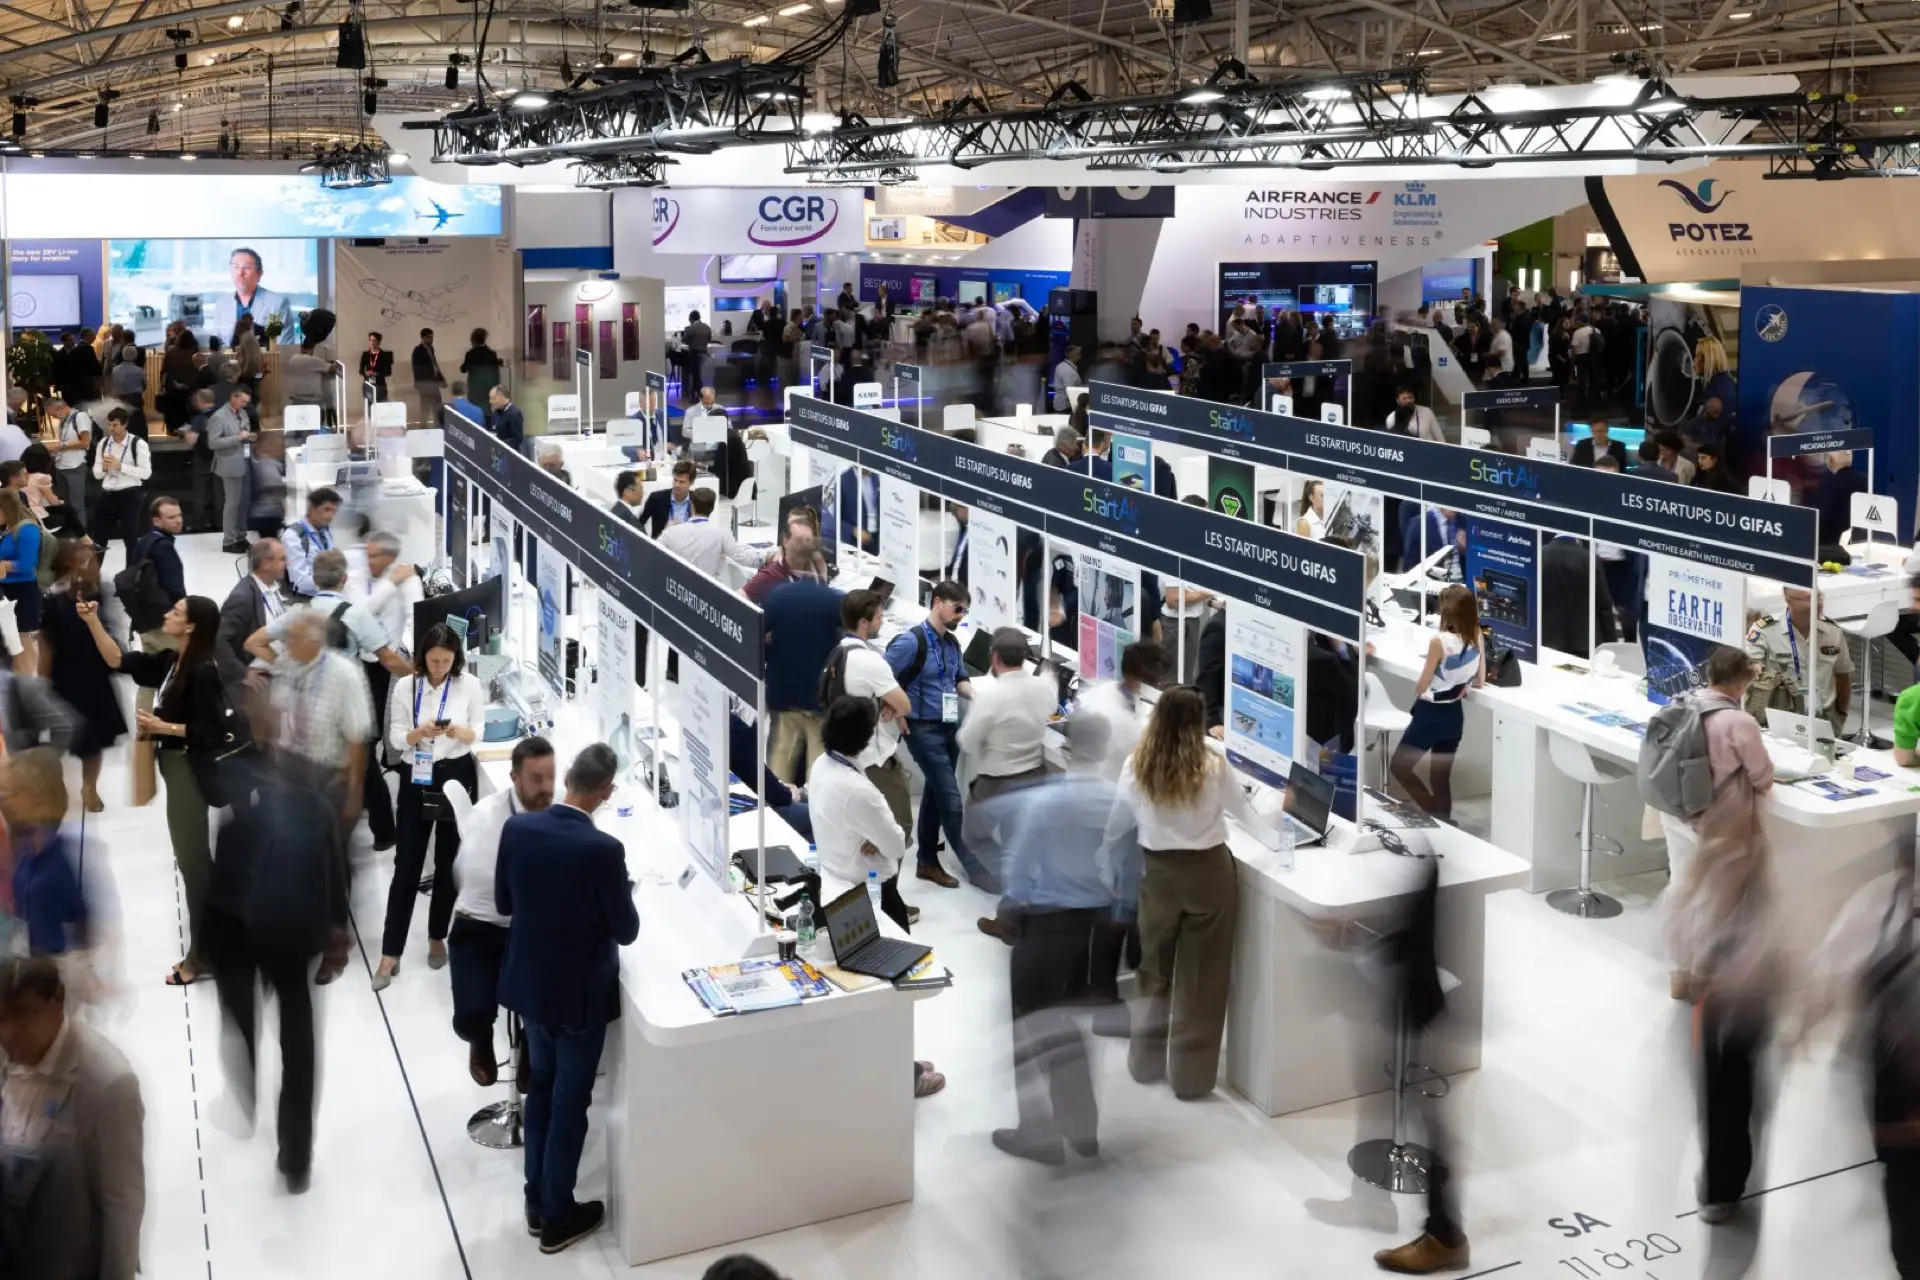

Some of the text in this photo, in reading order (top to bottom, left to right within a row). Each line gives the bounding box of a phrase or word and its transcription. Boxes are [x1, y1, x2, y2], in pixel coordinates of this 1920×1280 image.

[758, 195, 825, 222] CGR
[1246, 190, 1362, 204] AIRFRANCE
[1394, 193, 1436, 206] KLM
[1244, 207, 1362, 220] INDUSTRIES
[1668, 223, 1753, 242] POTEZ
[1305, 433, 1404, 463] LES STARTUPS DU GIFAS
[1826, 440, 1844, 448] GROUP
[955, 455, 1033, 490] LES STARTUPS DU GIFAS
[1469, 458, 1540, 490] StartAir
[1476, 503, 1500, 515] MOMENT
[1504, 509, 1526, 520] AIRFREE
[1621, 492, 1784, 538] LES STARTUPS DU GIFAS
[1205, 530, 1337, 585] LES STARTUPS DU GIFAS
[1639, 538, 1679, 555] PROMETHEE
[1679, 546, 1702, 560] EARTH
[1703, 554, 1755, 572] INTELLIGENCE
[666, 576, 743, 644] LES STARTUPS DU GIFAS
[1668, 589, 1723, 625] EARTH
[1668, 613, 1723, 638] OBSERVATION
[1548, 1212, 1611, 1237] SA
[1626, 1233, 1682, 1261] 20
